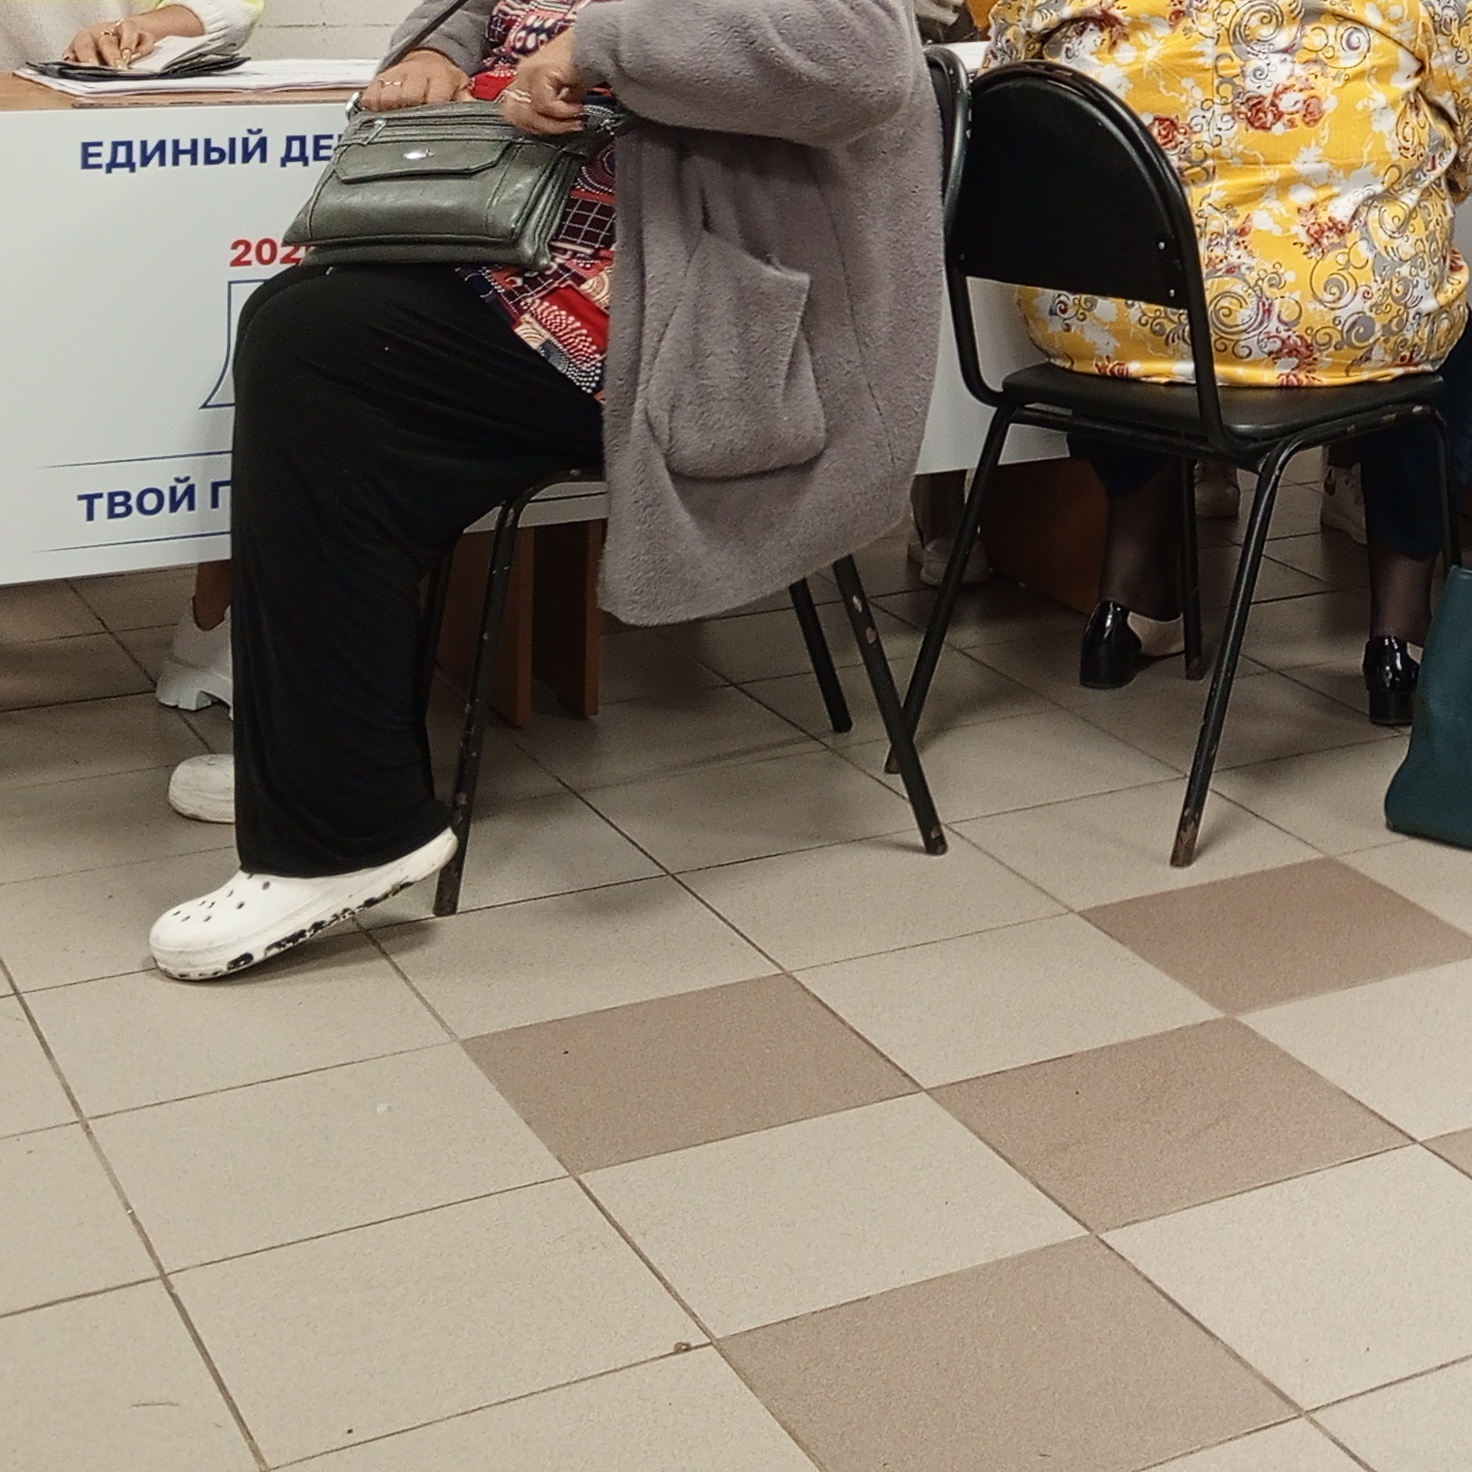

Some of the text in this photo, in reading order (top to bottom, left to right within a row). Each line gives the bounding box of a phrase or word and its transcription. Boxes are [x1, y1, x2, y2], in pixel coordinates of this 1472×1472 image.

[80, 128, 343, 174] ЕДИНЫЙ ДЕ
[230, 238, 314, 268] 202
[77, 476, 196, 522] ТВОЙ
